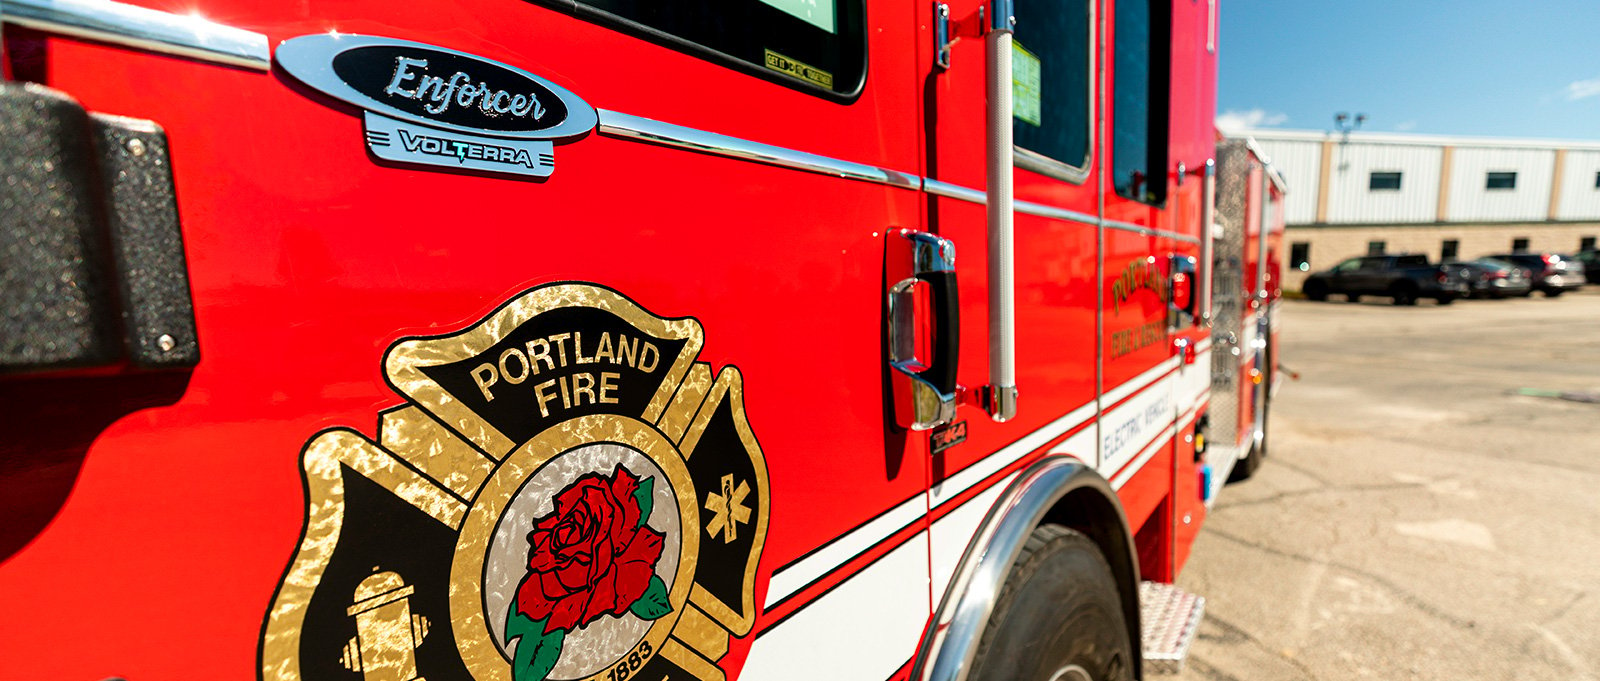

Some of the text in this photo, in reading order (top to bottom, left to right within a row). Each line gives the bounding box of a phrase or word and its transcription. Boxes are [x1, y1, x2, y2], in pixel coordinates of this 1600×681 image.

[384, 56, 547, 120] Enforcer
[399, 129, 534, 168] VOLTERRA
[470, 331, 660, 402] PORTLAND
[534, 371, 621, 418] FIRE
[606, 640, 653, 681] 1883
